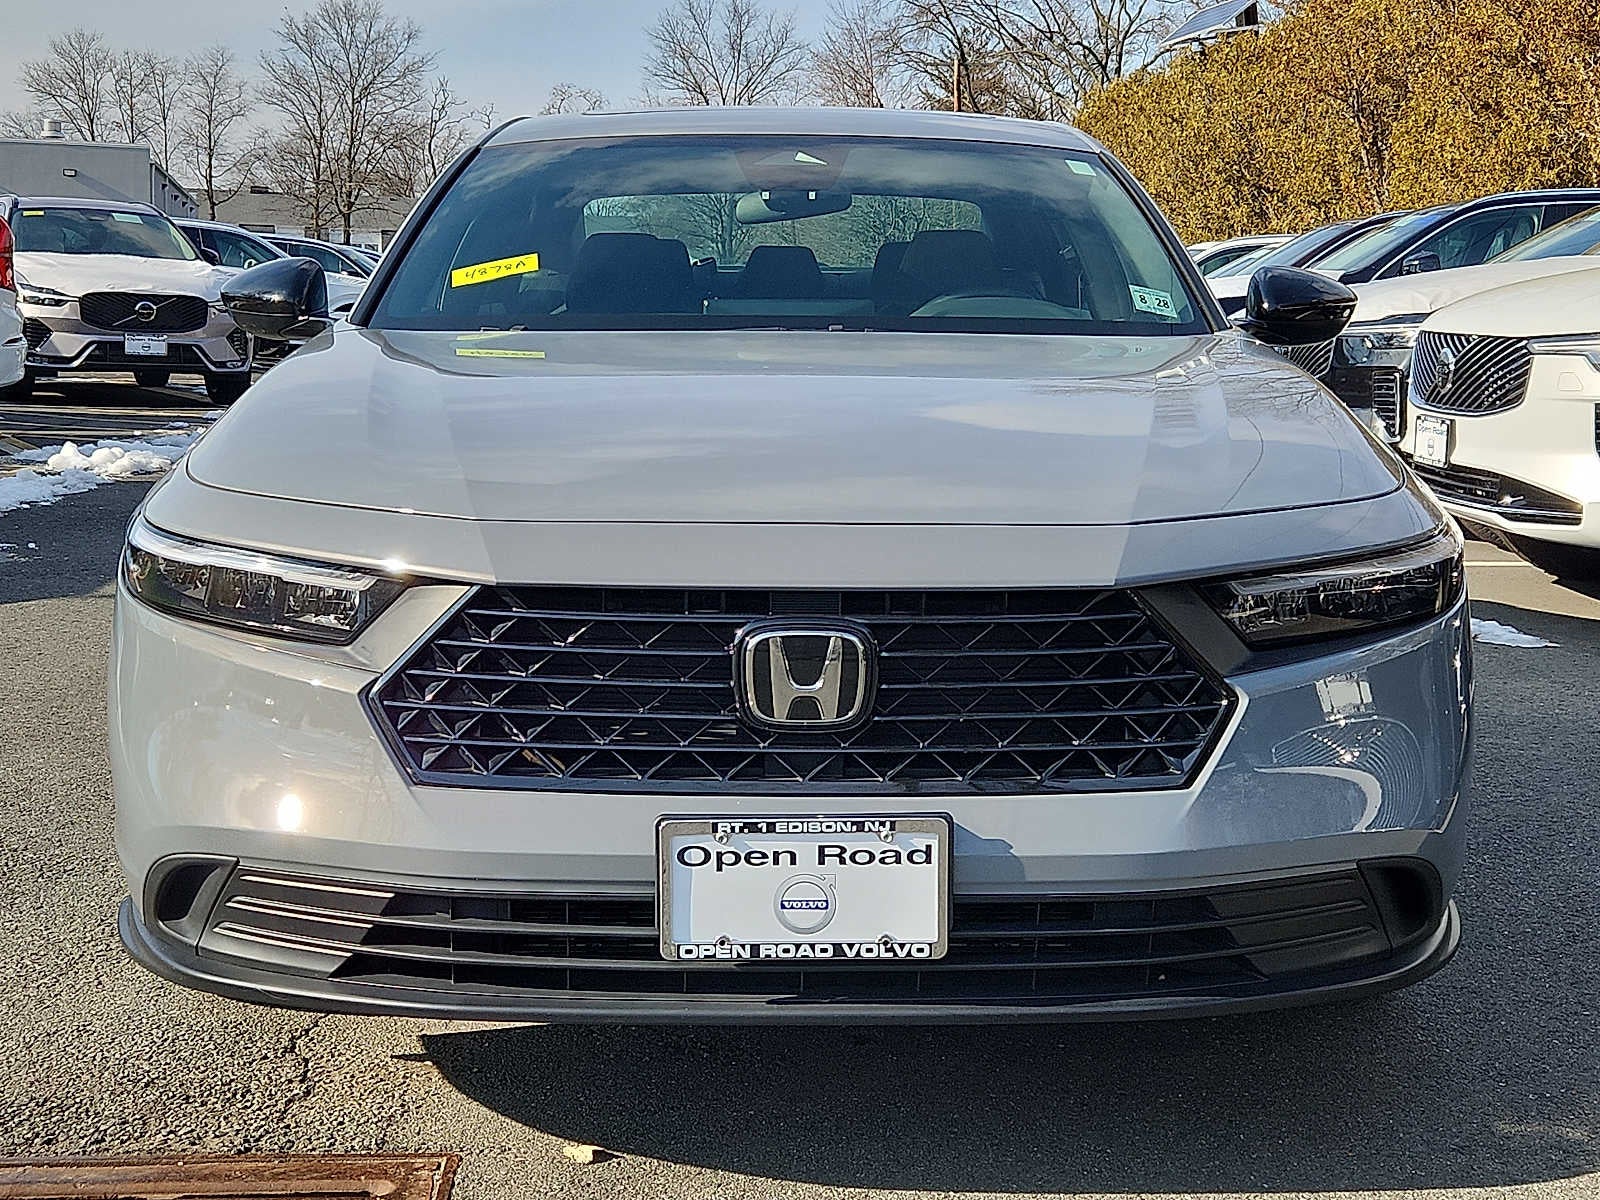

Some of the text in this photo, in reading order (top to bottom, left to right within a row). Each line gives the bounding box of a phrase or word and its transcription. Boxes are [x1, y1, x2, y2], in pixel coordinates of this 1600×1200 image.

[1139, 294, 1170, 308] 8 28
[758, 821, 767, 832] 1
[775, 820, 857, 834] EDISON,
[676, 844, 932, 872] Open Road
[783, 900, 827, 910] VOLVO
[679, 944, 930, 959] OPEN ROAD VOLVO
